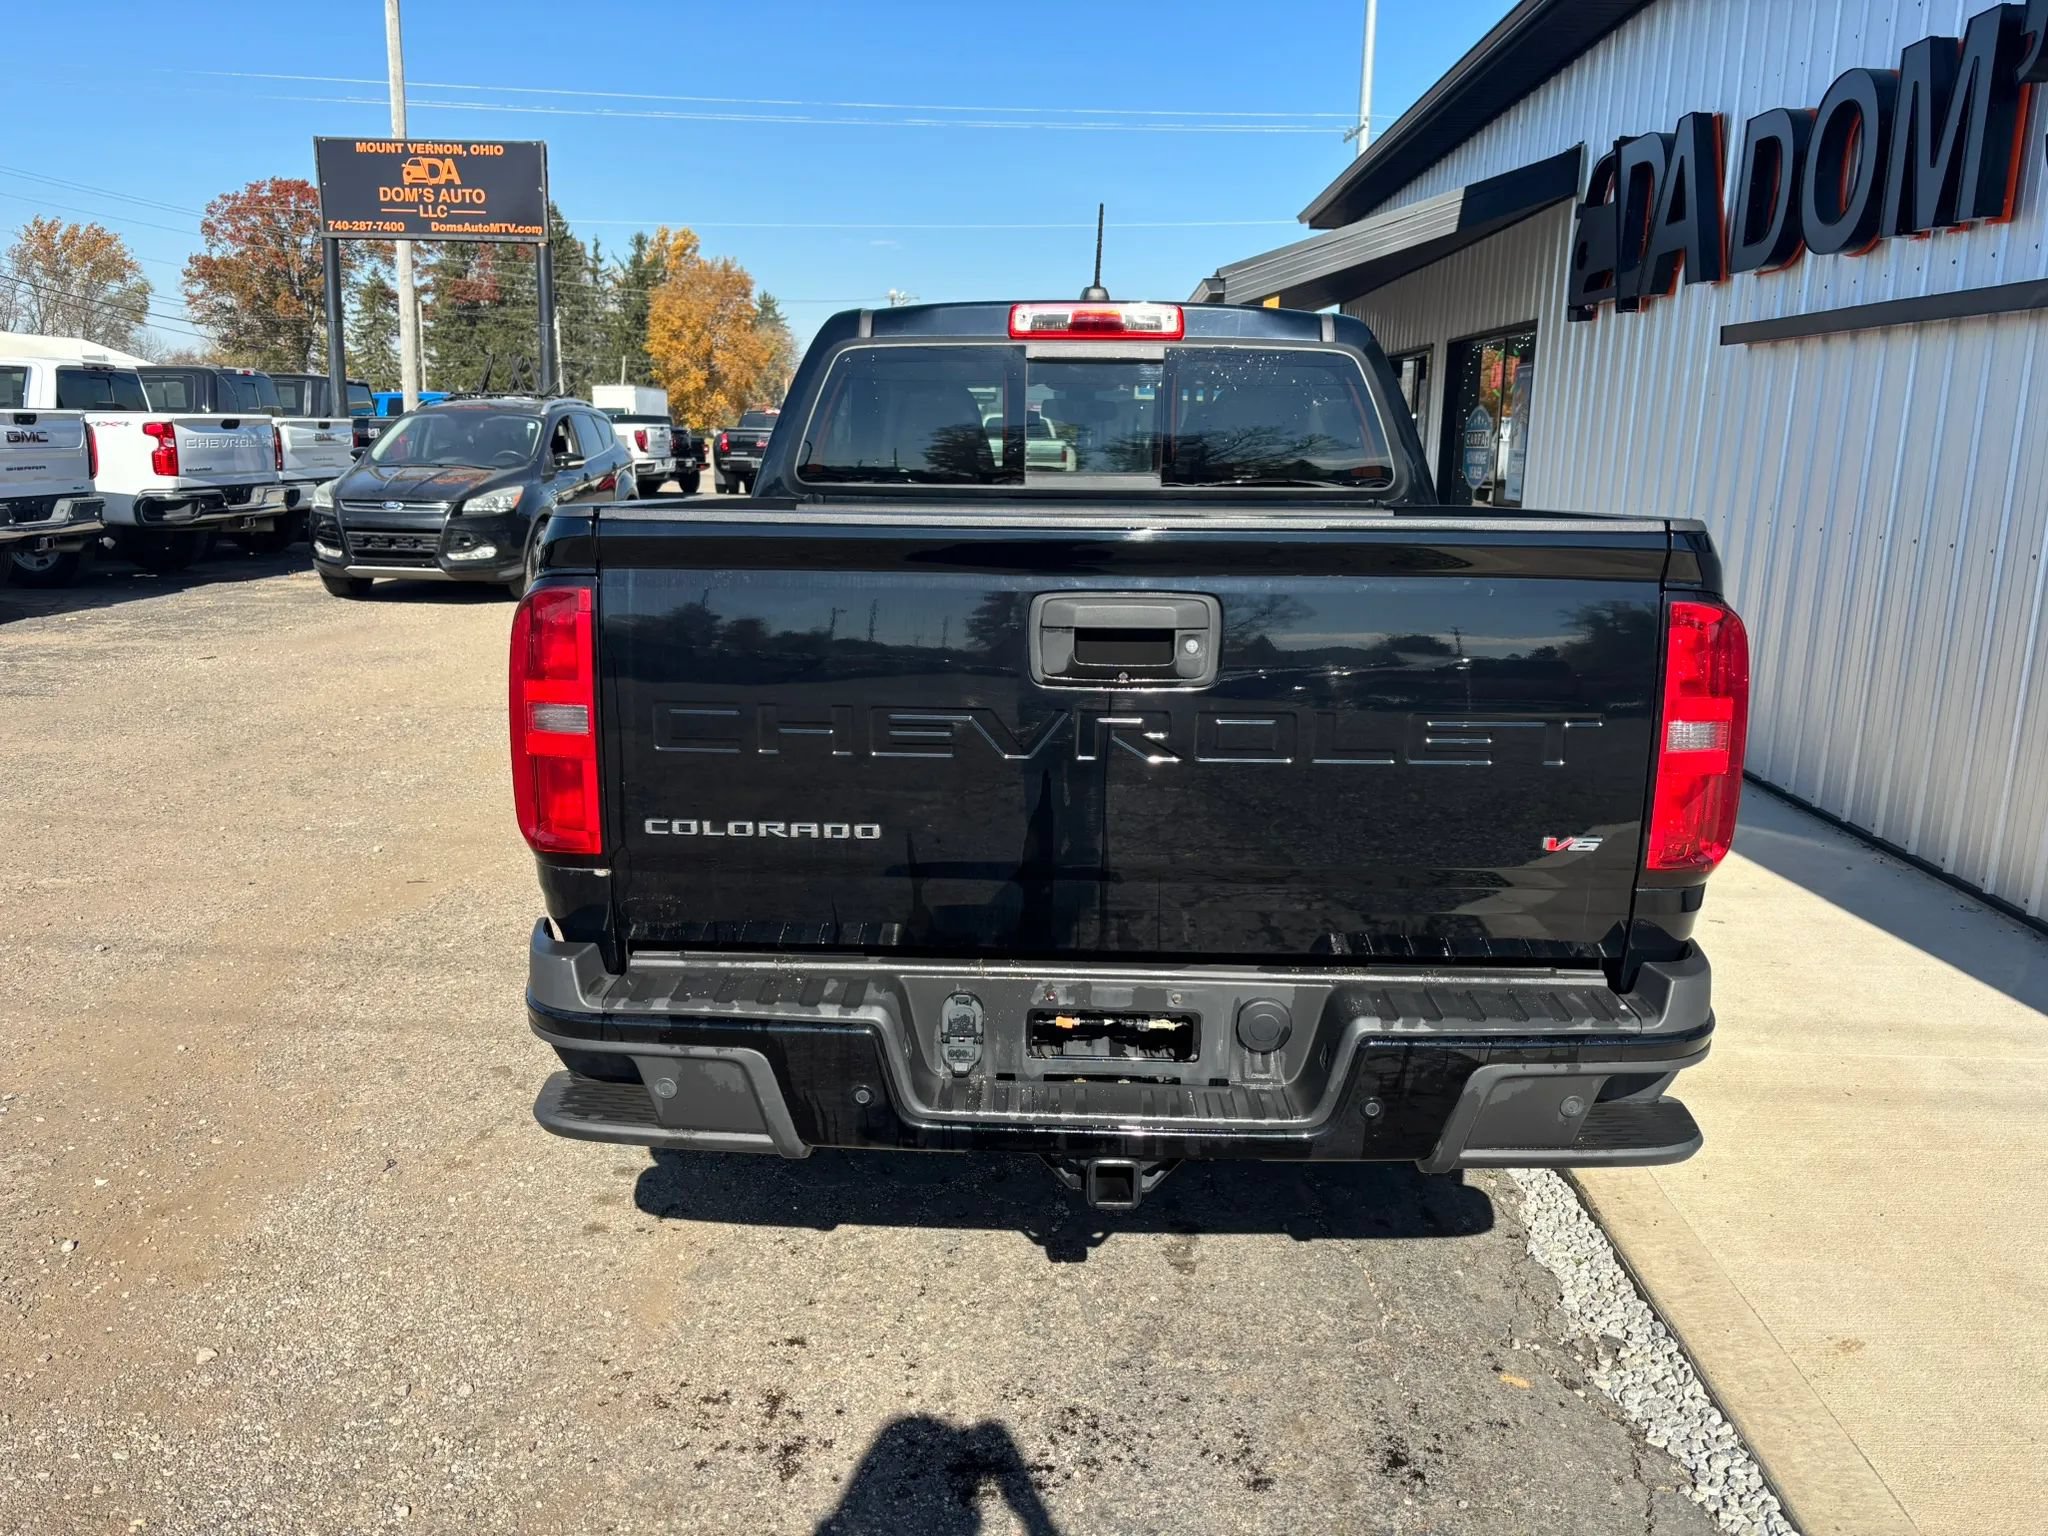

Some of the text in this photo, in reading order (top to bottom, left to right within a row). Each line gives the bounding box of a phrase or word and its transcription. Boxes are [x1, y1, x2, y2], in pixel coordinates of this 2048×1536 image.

[1728, 0, 2048, 275] DOM'
[355, 142, 505, 158] MOUNT VERNON, OHIO
[379, 187, 486, 205] DOM'S AUTO
[419, 204, 448, 219] LLC
[328, 220, 405, 232] 740-287-7400
[431, 221, 543, 236] DomsAutoMTV.com
[6, 431, 49, 443] GMC
[653, 702, 1604, 767] CHEVROLET
[644, 817, 882, 841] COLORADO
[1542, 836, 1603, 853] V6
